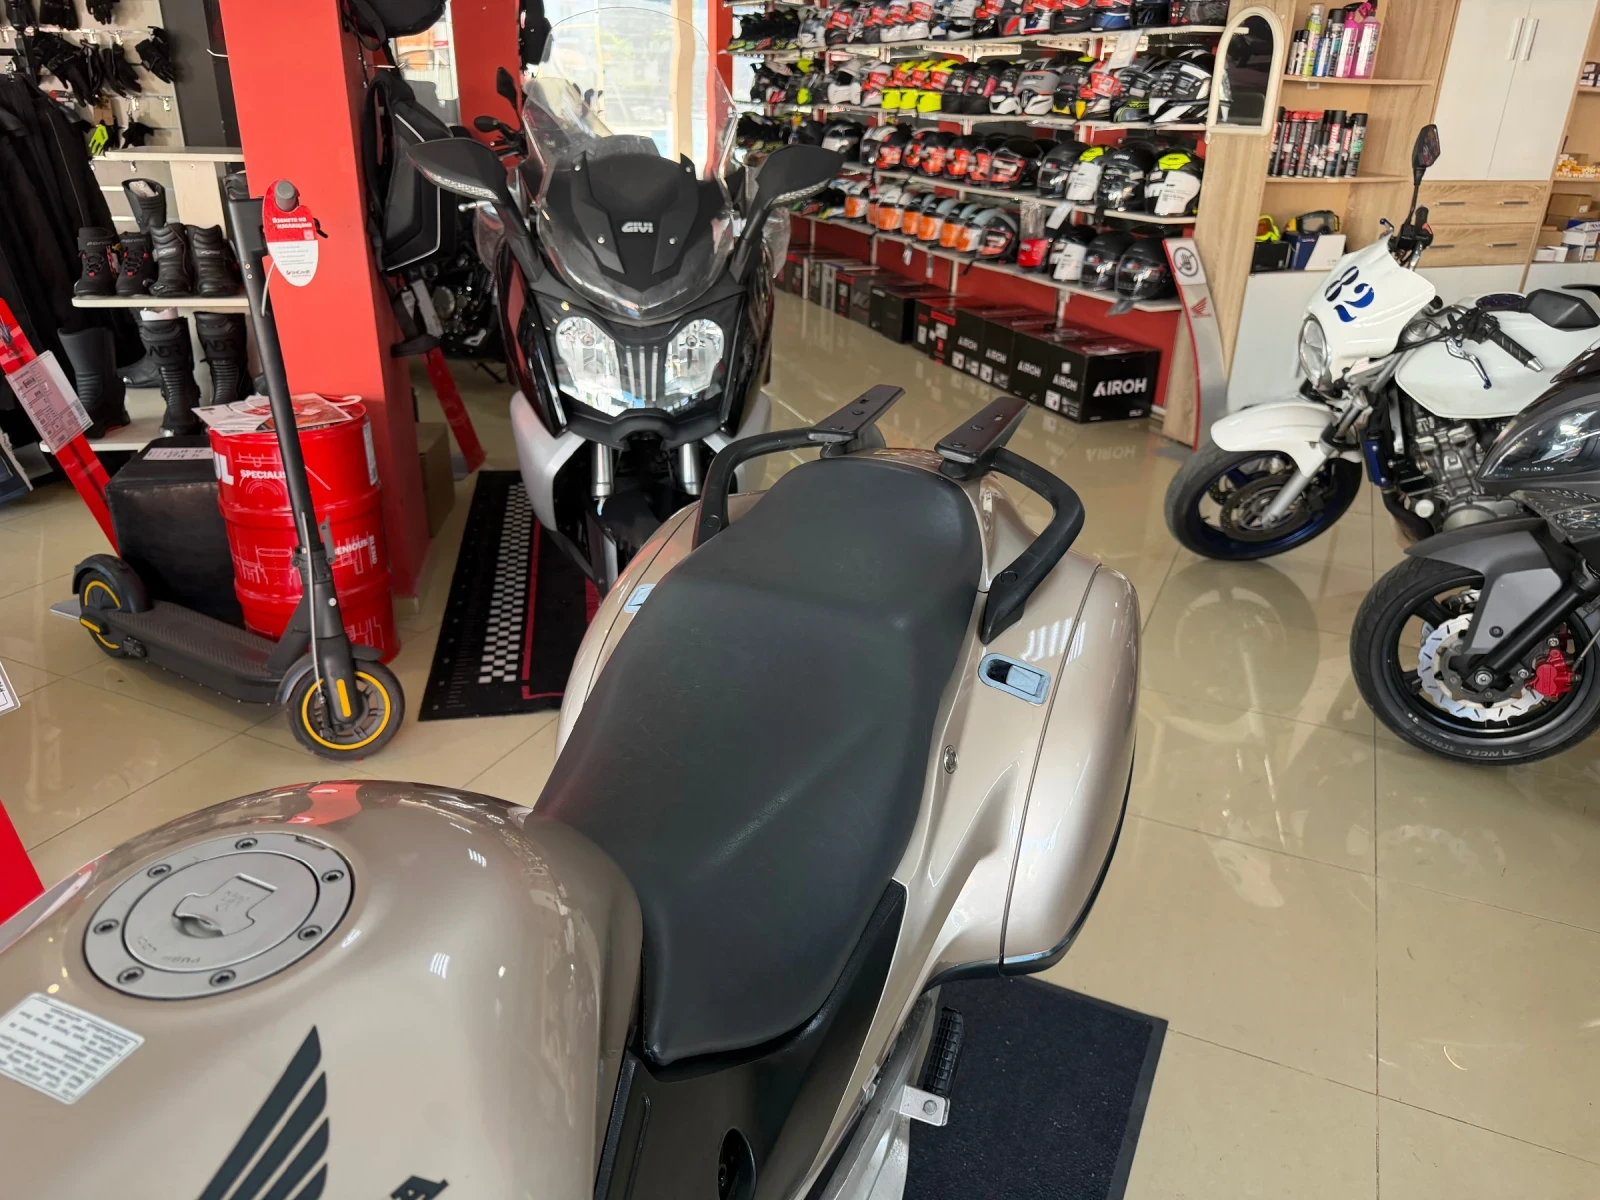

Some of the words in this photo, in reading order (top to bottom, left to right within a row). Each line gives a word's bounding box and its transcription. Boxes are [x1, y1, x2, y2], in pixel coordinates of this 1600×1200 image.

[621, 221, 654, 233] GIVI
[1324, 265, 1375, 323] 82
[1017, 360, 1042, 378] AIROH
[1053, 374, 1078, 391] AIROH
[1093, 378, 1148, 398] AIROH
